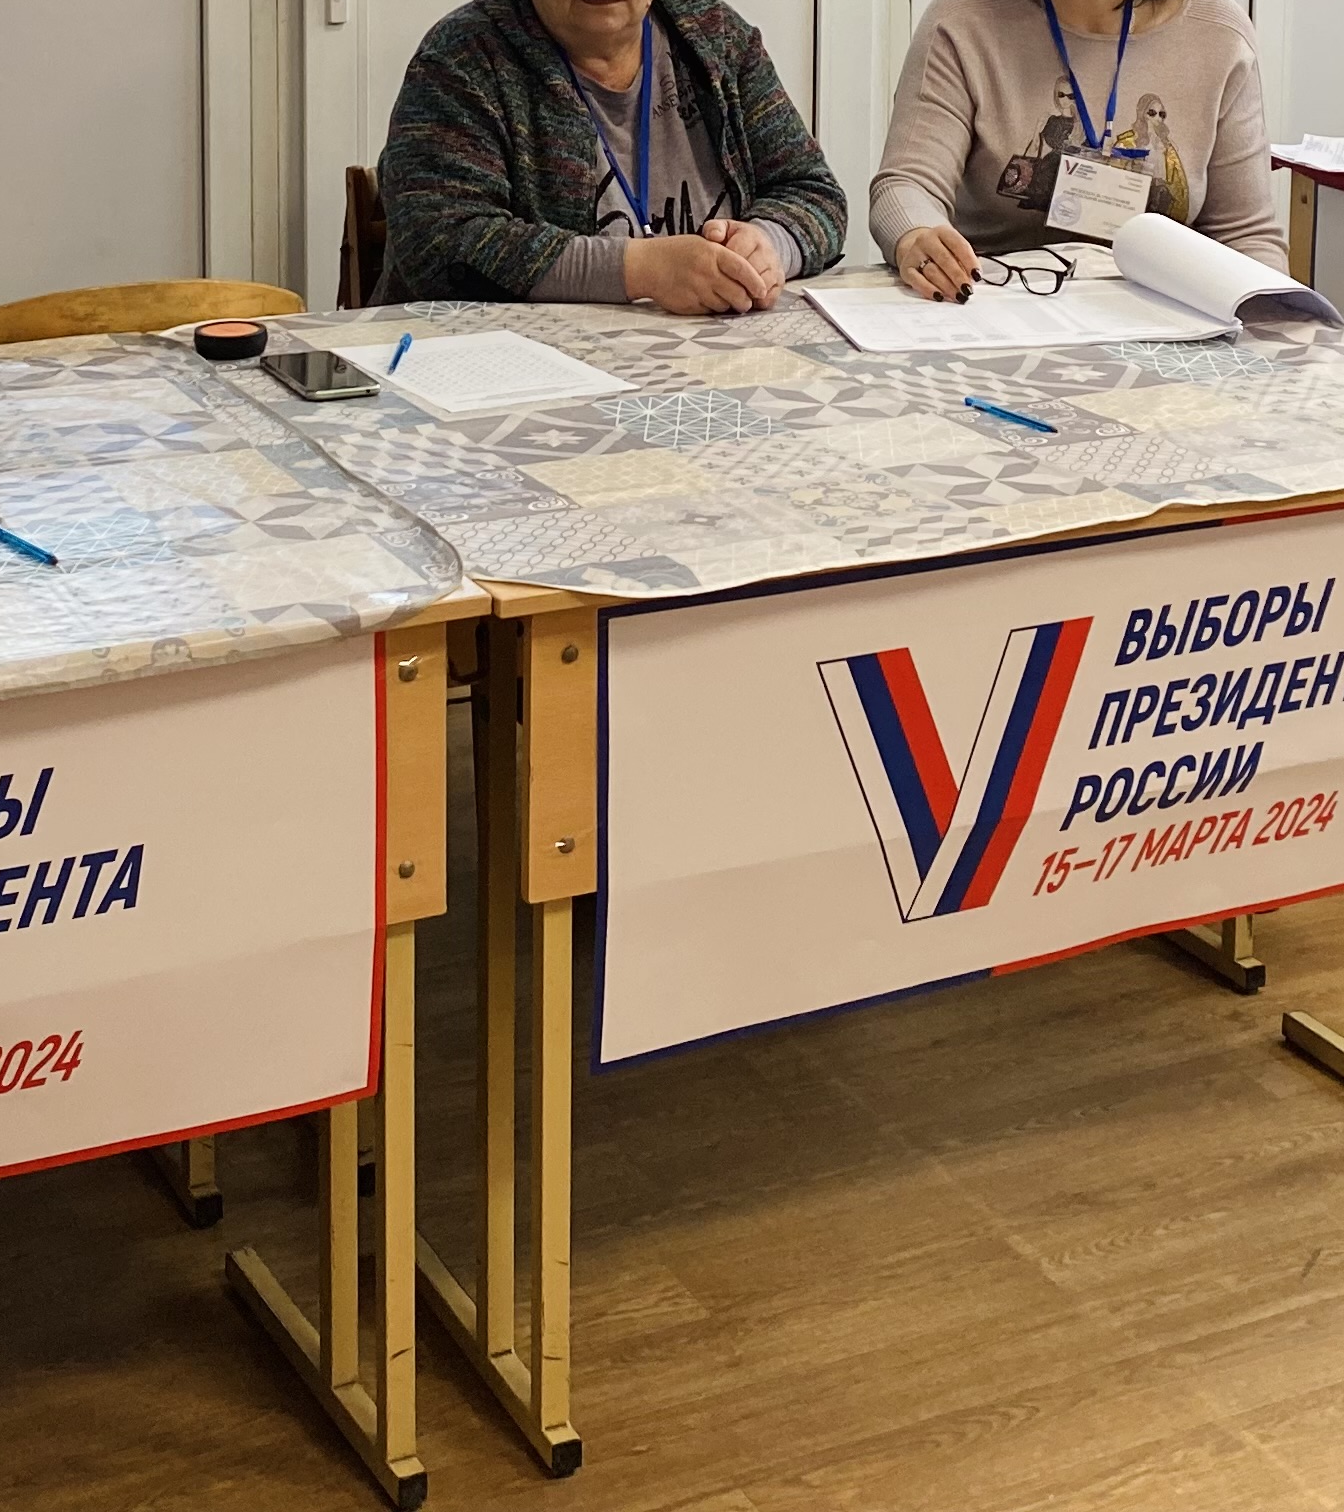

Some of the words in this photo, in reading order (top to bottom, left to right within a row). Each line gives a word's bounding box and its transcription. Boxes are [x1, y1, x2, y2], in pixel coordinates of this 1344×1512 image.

[1115, 576, 1336, 668] ВЫБОРЫ
[1060, 741, 1265, 832] РОССИИ
[1131, 807, 1252, 872] МАРТА
[1252, 790, 1339, 849] 2024
